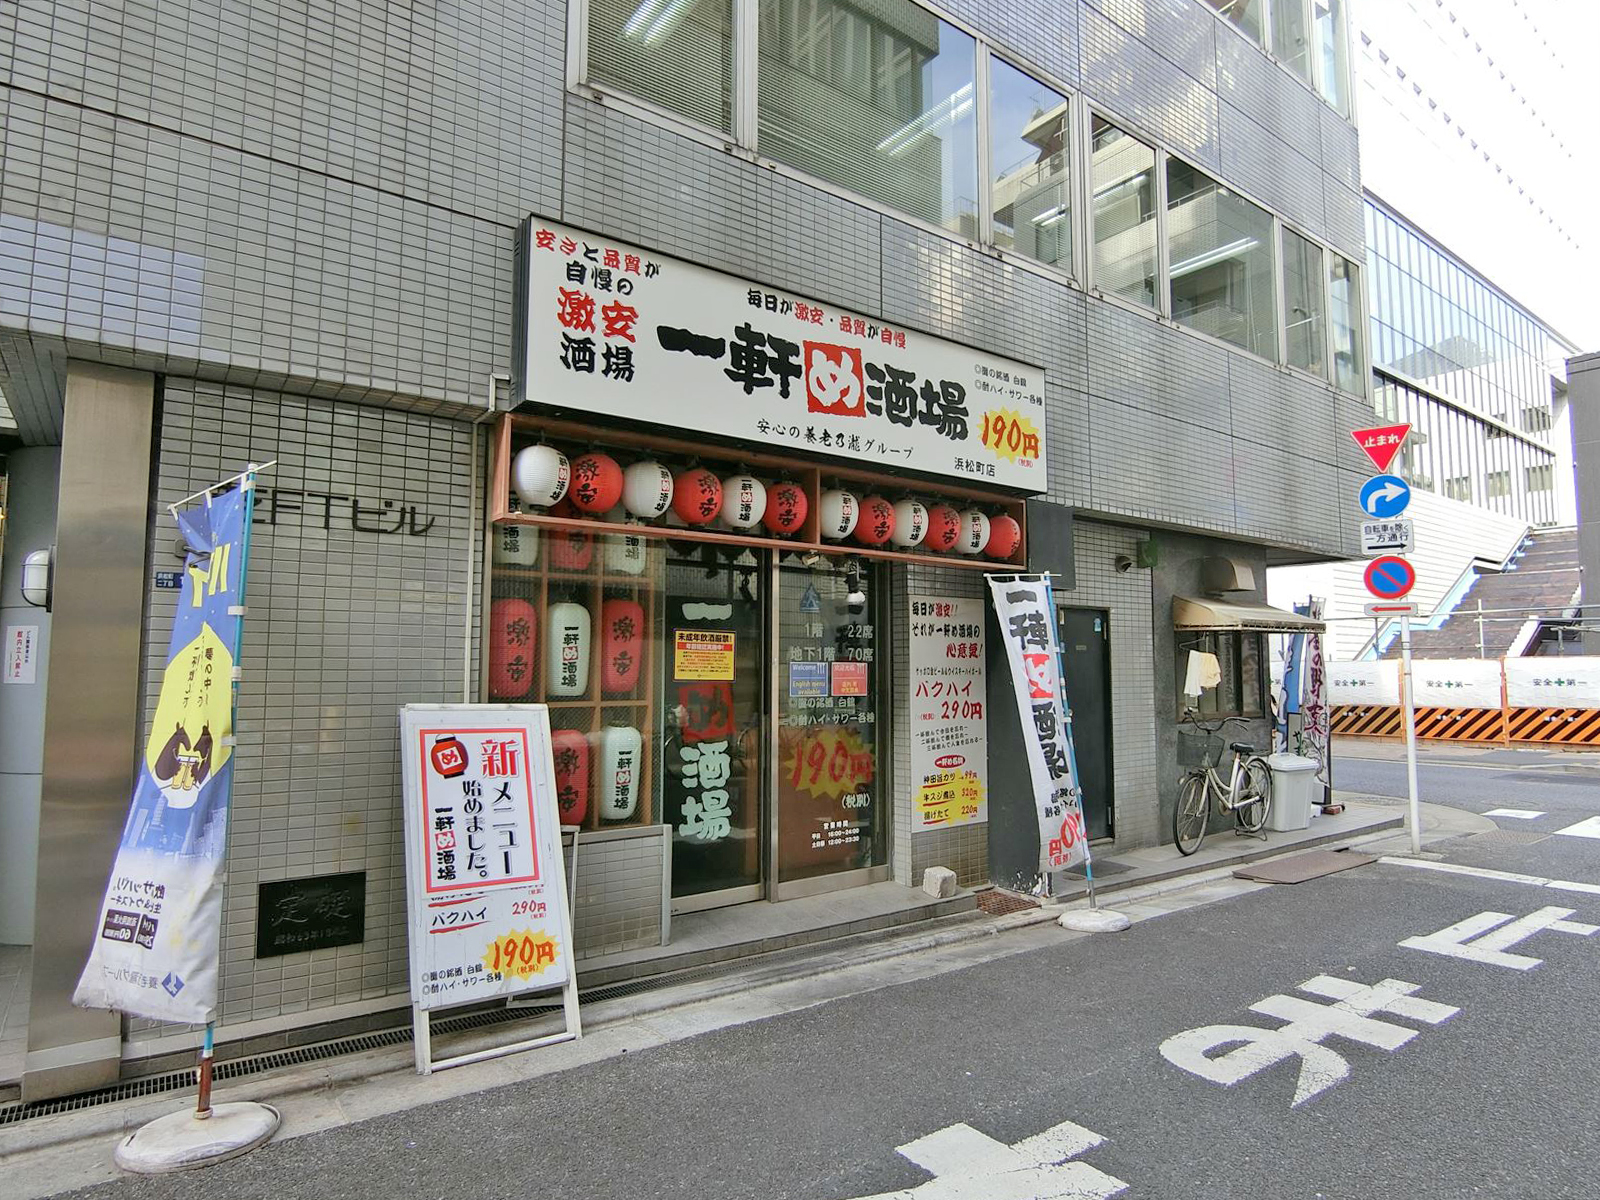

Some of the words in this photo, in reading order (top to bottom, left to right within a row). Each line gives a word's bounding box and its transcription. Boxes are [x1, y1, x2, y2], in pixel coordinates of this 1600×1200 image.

[566, 260, 634, 296] 自慢の
[556, 286, 640, 343] 激安
[747, 288, 906, 349] 毎日が激安・品質が自慢
[560, 331, 635, 383] 酒場
[656, 321, 970, 441] 一軒め酒場
[981, 411, 1039, 460] 190円
[1363, 433, 1400, 448] 止まれ
[954, 456, 996, 478] 浜松町店
[738, 478, 753, 523] 一軒め酒場
[1364, 523, 1409, 536] 自転車を除く
[1365, 531, 1409, 543] 一方通行
[804, 622, 824, 638] 1階
[847, 624, 874, 639] 22席
[561, 626, 580, 688] 一軒め酒場
[789, 645, 836, 662] 地下1階
[847, 647, 874, 661] 70席
[915, 680, 973, 698] バクハイ
[941, 700, 982, 720] 290円
[441, 750, 459, 766] め
[791, 740, 873, 788] 190円
[613, 750, 632, 810] 一軒め酒場
[435, 806, 457, 881] 一軒め酒場
[462, 779, 488, 878] 始めました。
[432, 906, 487, 926] バクハイ
[512, 899, 547, 916] 290円
[493, 935, 556, 971] 190円
